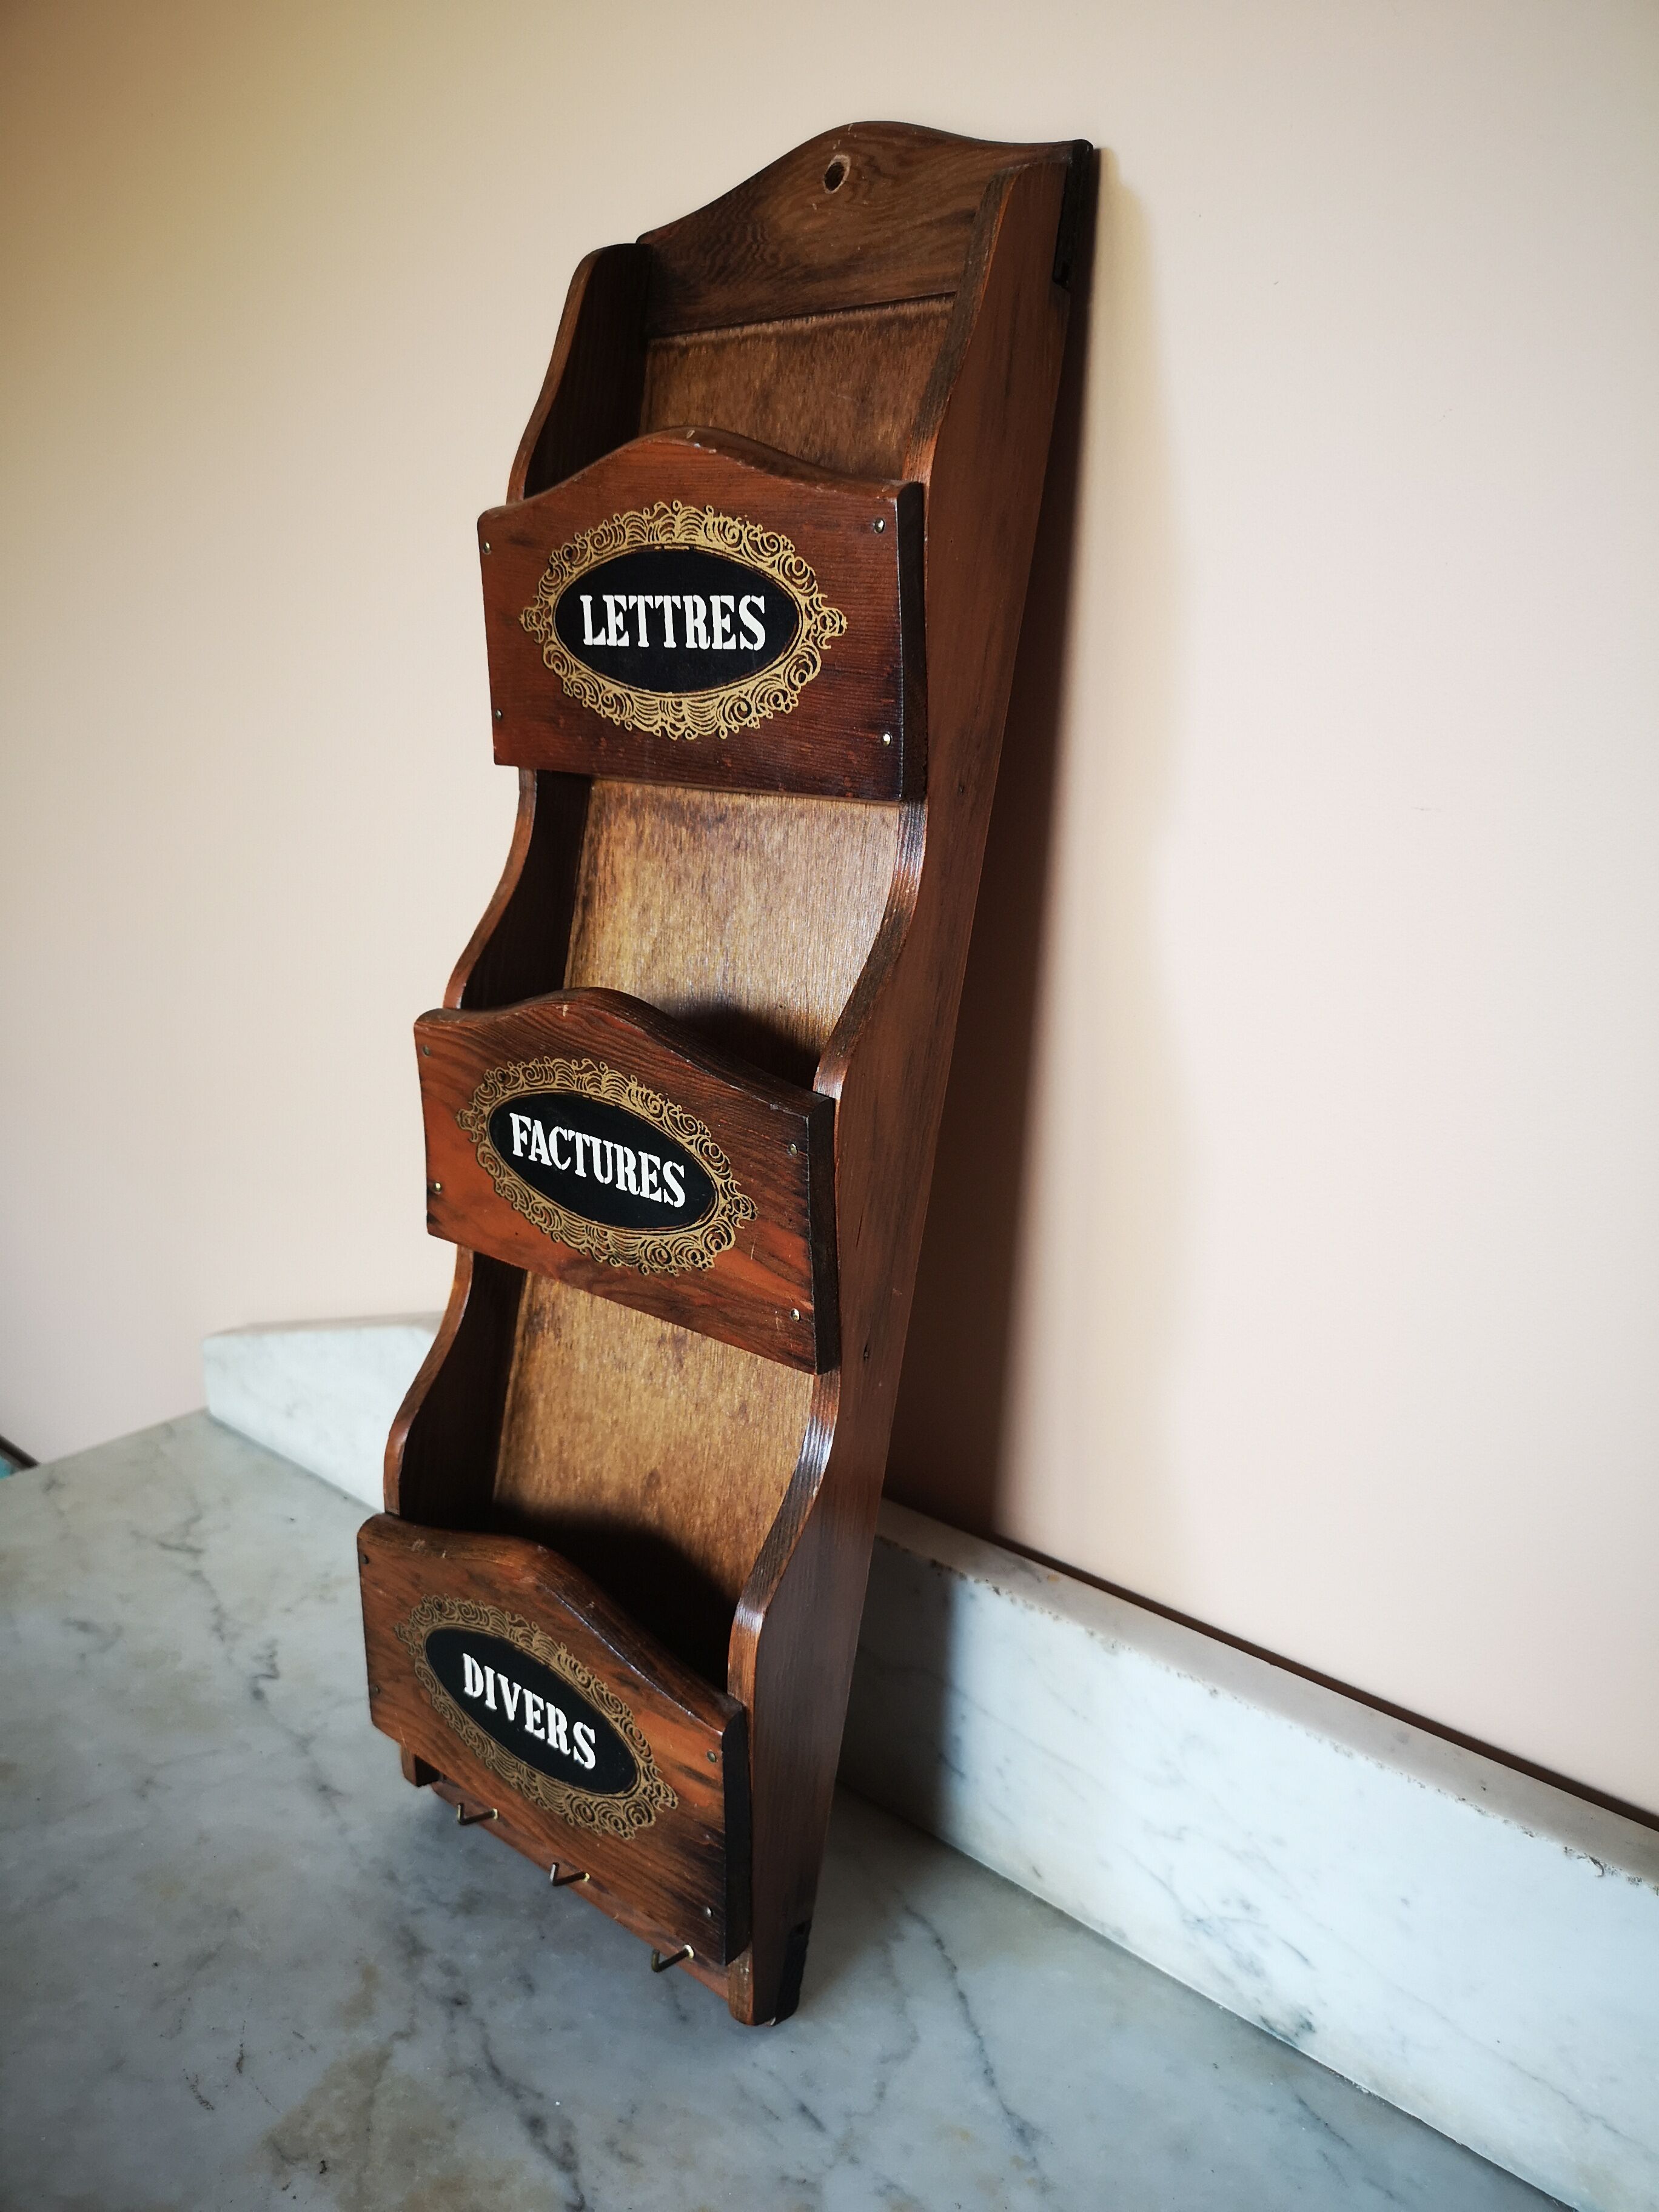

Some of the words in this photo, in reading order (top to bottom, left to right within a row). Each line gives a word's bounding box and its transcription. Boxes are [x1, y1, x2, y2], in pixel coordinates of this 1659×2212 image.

[579, 594, 766, 651] LETTRES
[509, 1112, 686, 1208] FACTURES
[461, 1652, 597, 1770] DIVERS
